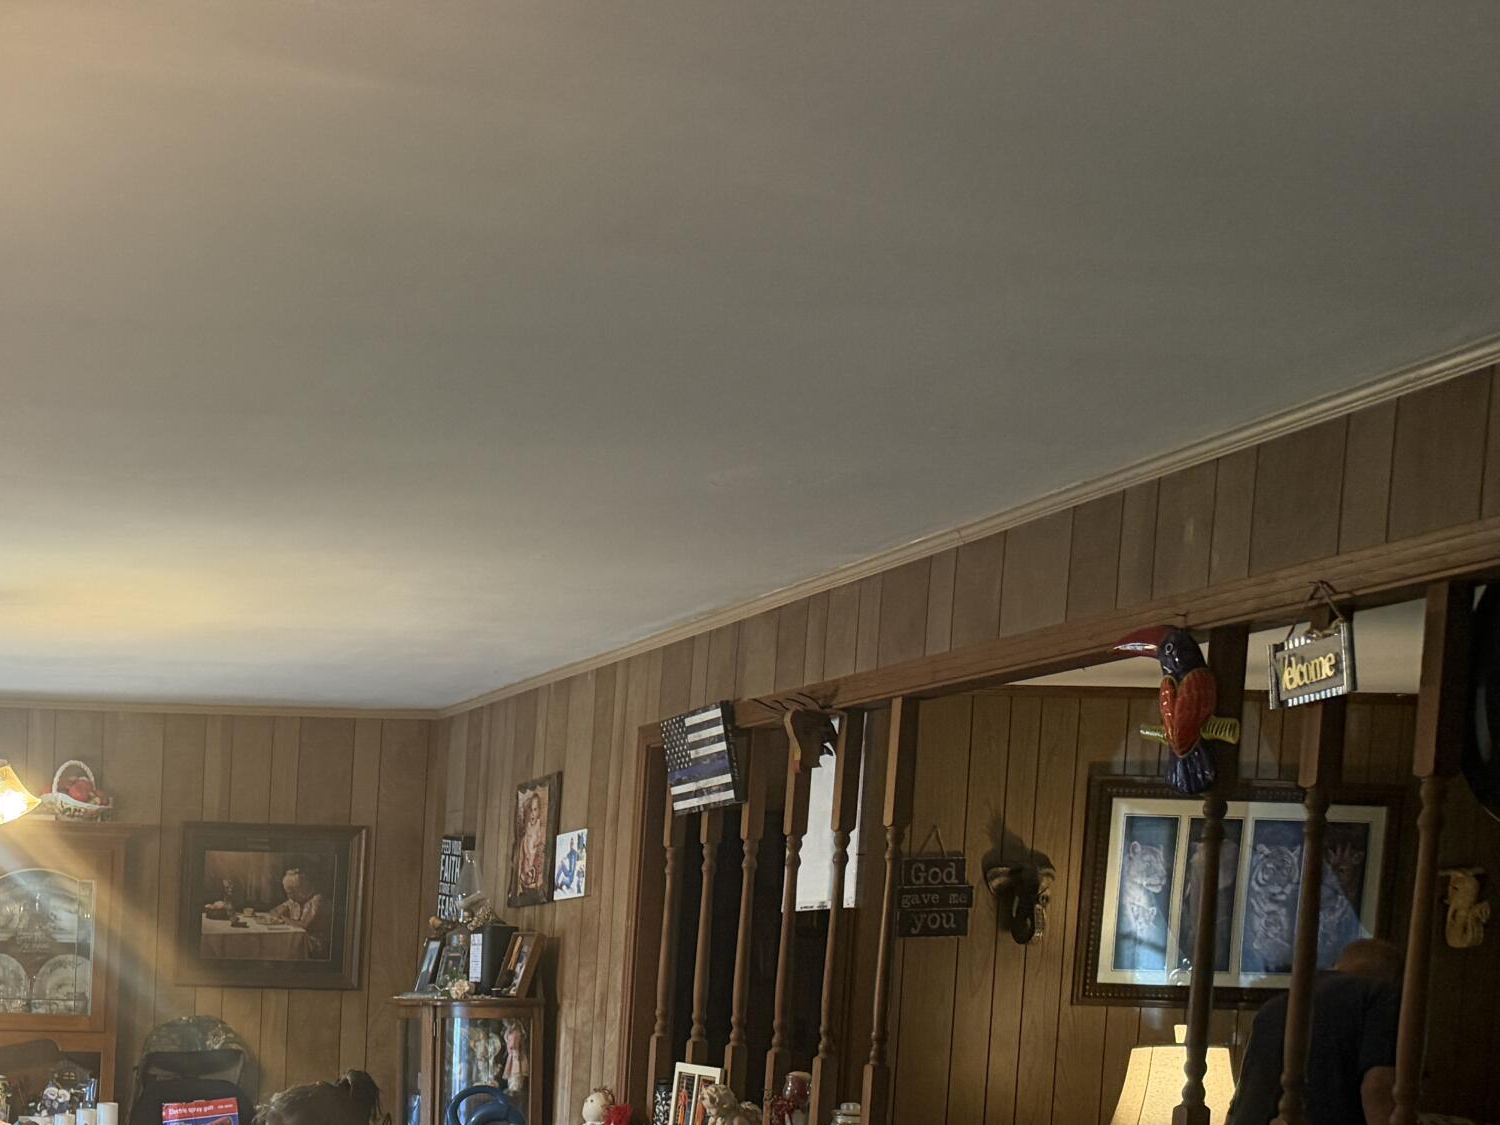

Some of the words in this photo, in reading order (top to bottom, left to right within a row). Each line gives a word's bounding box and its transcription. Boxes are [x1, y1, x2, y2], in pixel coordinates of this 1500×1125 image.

[440, 853, 461, 884] FAITH
[910, 861, 959, 885] God
[901, 892, 940, 908] gave
[948, 893, 968, 904] me
[910, 912, 956, 934] you
